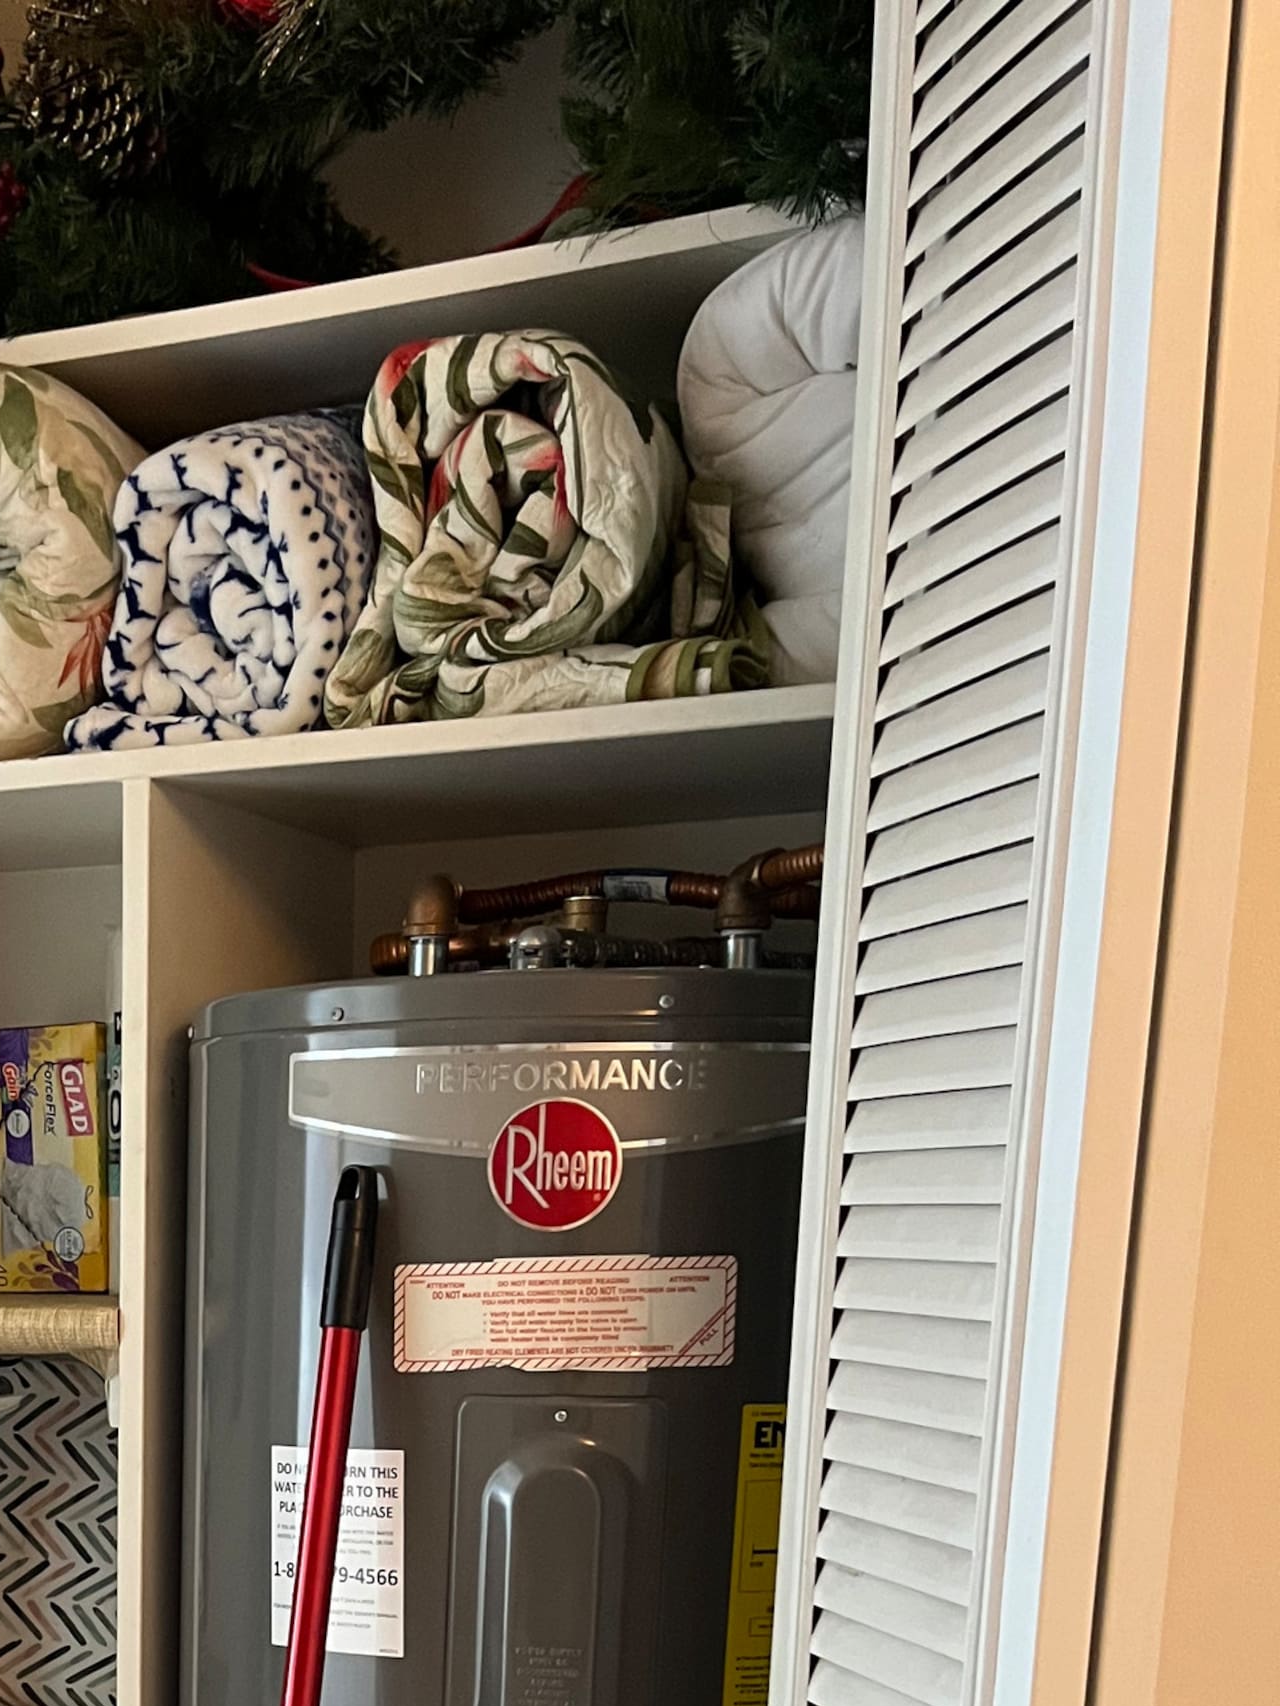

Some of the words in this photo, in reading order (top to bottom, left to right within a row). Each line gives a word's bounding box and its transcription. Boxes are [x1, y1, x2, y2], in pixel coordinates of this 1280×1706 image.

[3, 1063, 20, 1101] Gain
[415, 1058, 706, 1094] PERFORMANCE
[61, 1064, 89, 1133] GLAD
[505, 1103, 613, 1208] Rheem
[497, 1280, 508, 1288] DO
[432, 1291, 444, 1300] DO
[445, 1291, 461, 1299] NOT
[586, 1287, 597, 1296] DO
[600, 1287, 616, 1295] NOT
[277, 1462, 292, 1474] DO
[370, 1467, 398, 1479] THIS
[274, 1481, 302, 1493] WATE
[356, 1485, 373, 1498] TO
[376, 1486, 398, 1498] THE
